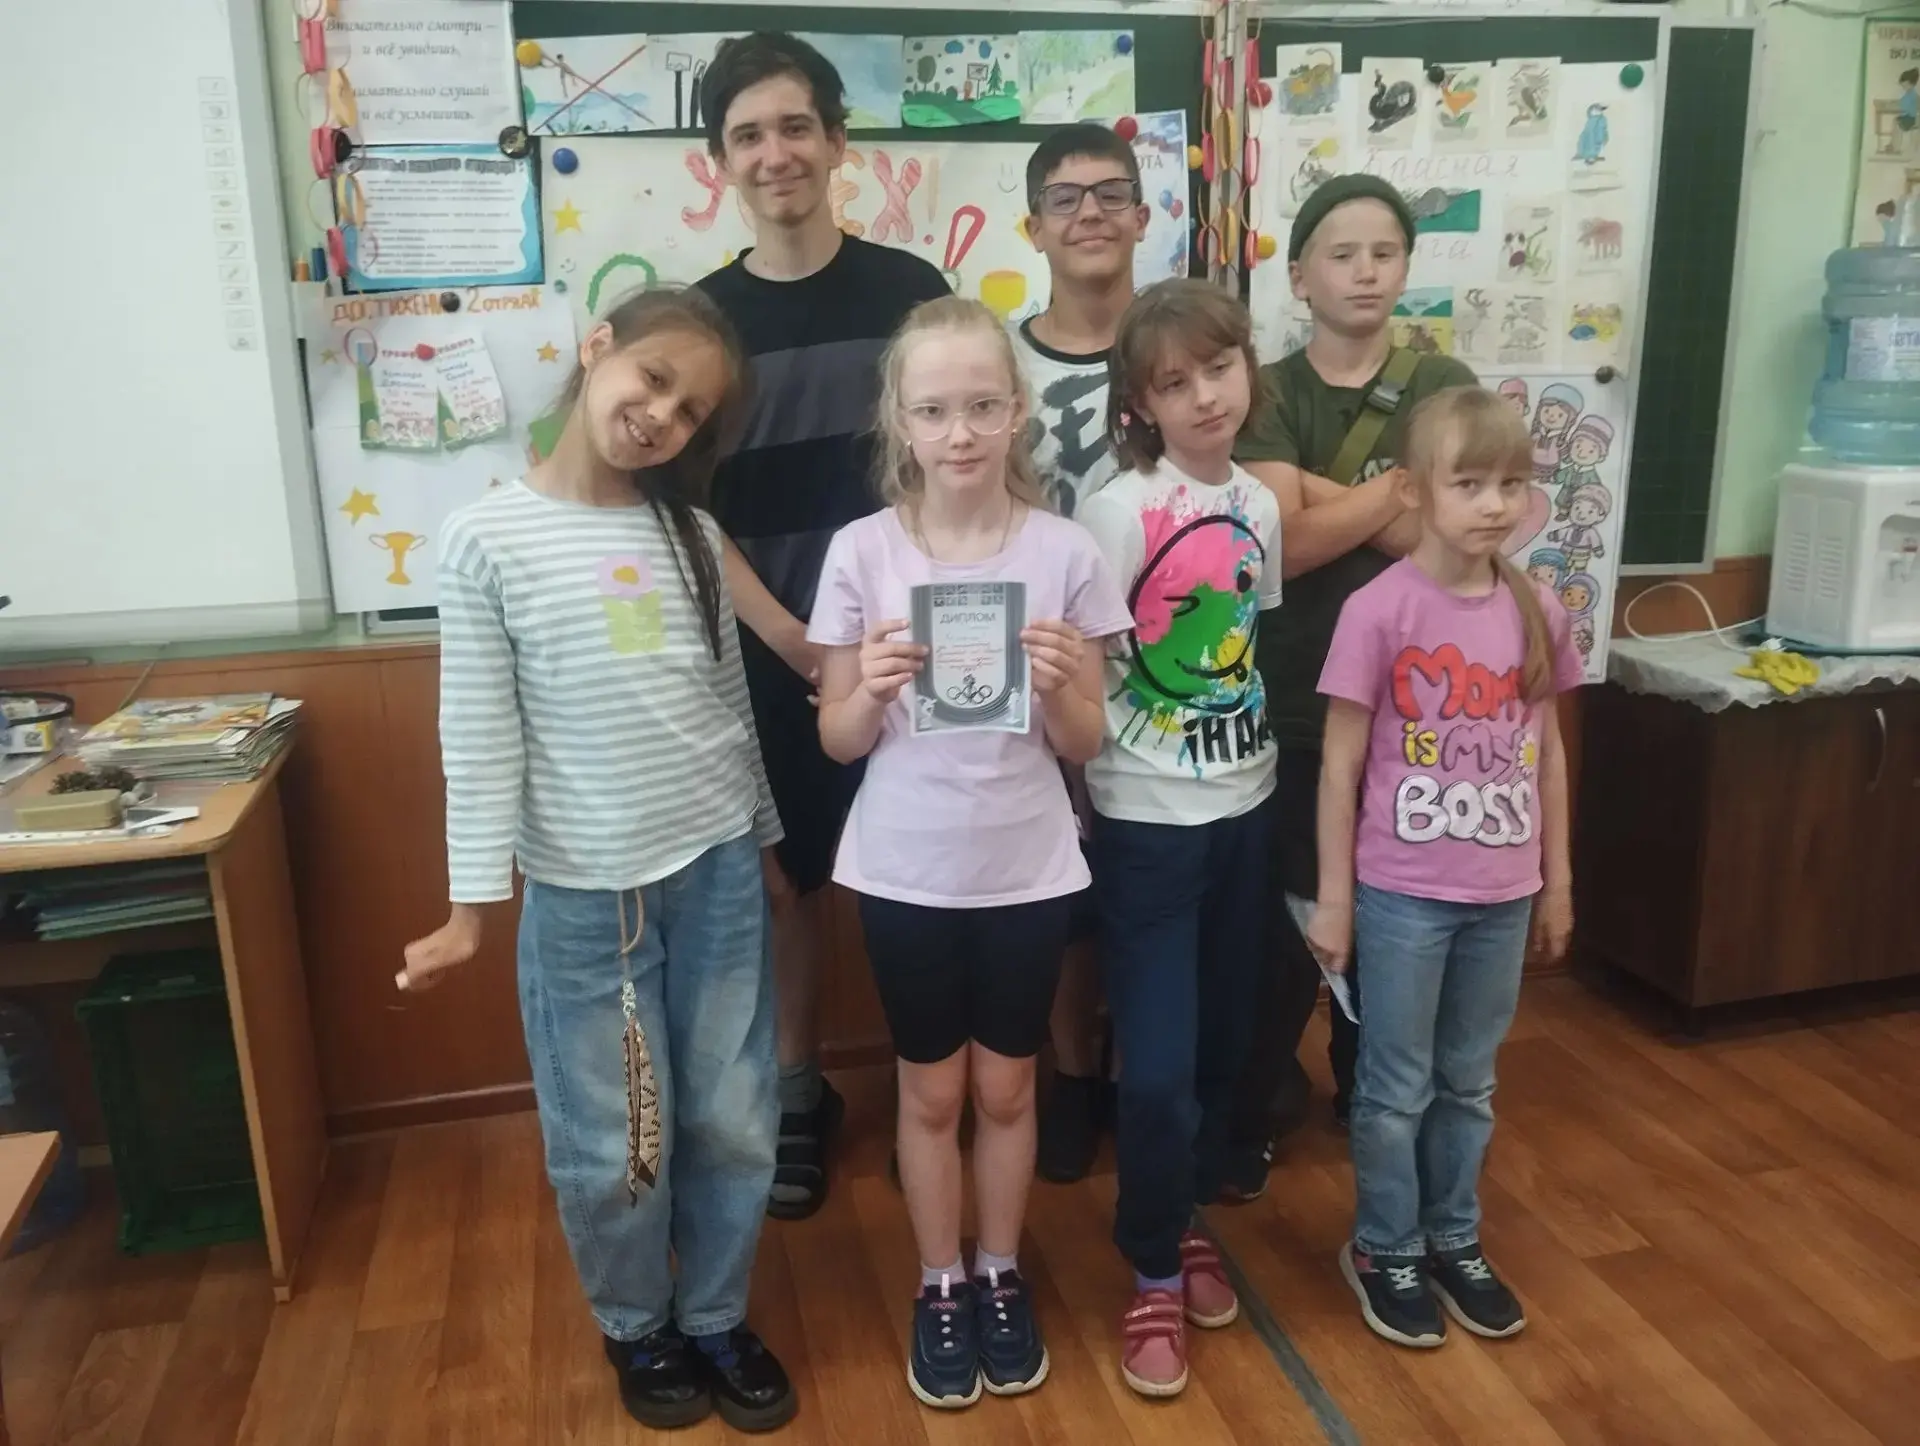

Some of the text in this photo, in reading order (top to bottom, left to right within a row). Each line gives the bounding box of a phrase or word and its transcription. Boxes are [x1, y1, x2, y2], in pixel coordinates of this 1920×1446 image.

[681, 147, 941, 246] УЕХ!
[466, 287, 479, 313] 2
[939, 612, 997, 624] ДИПЛОМ
[1396, 775, 1532, 848] BOSS
